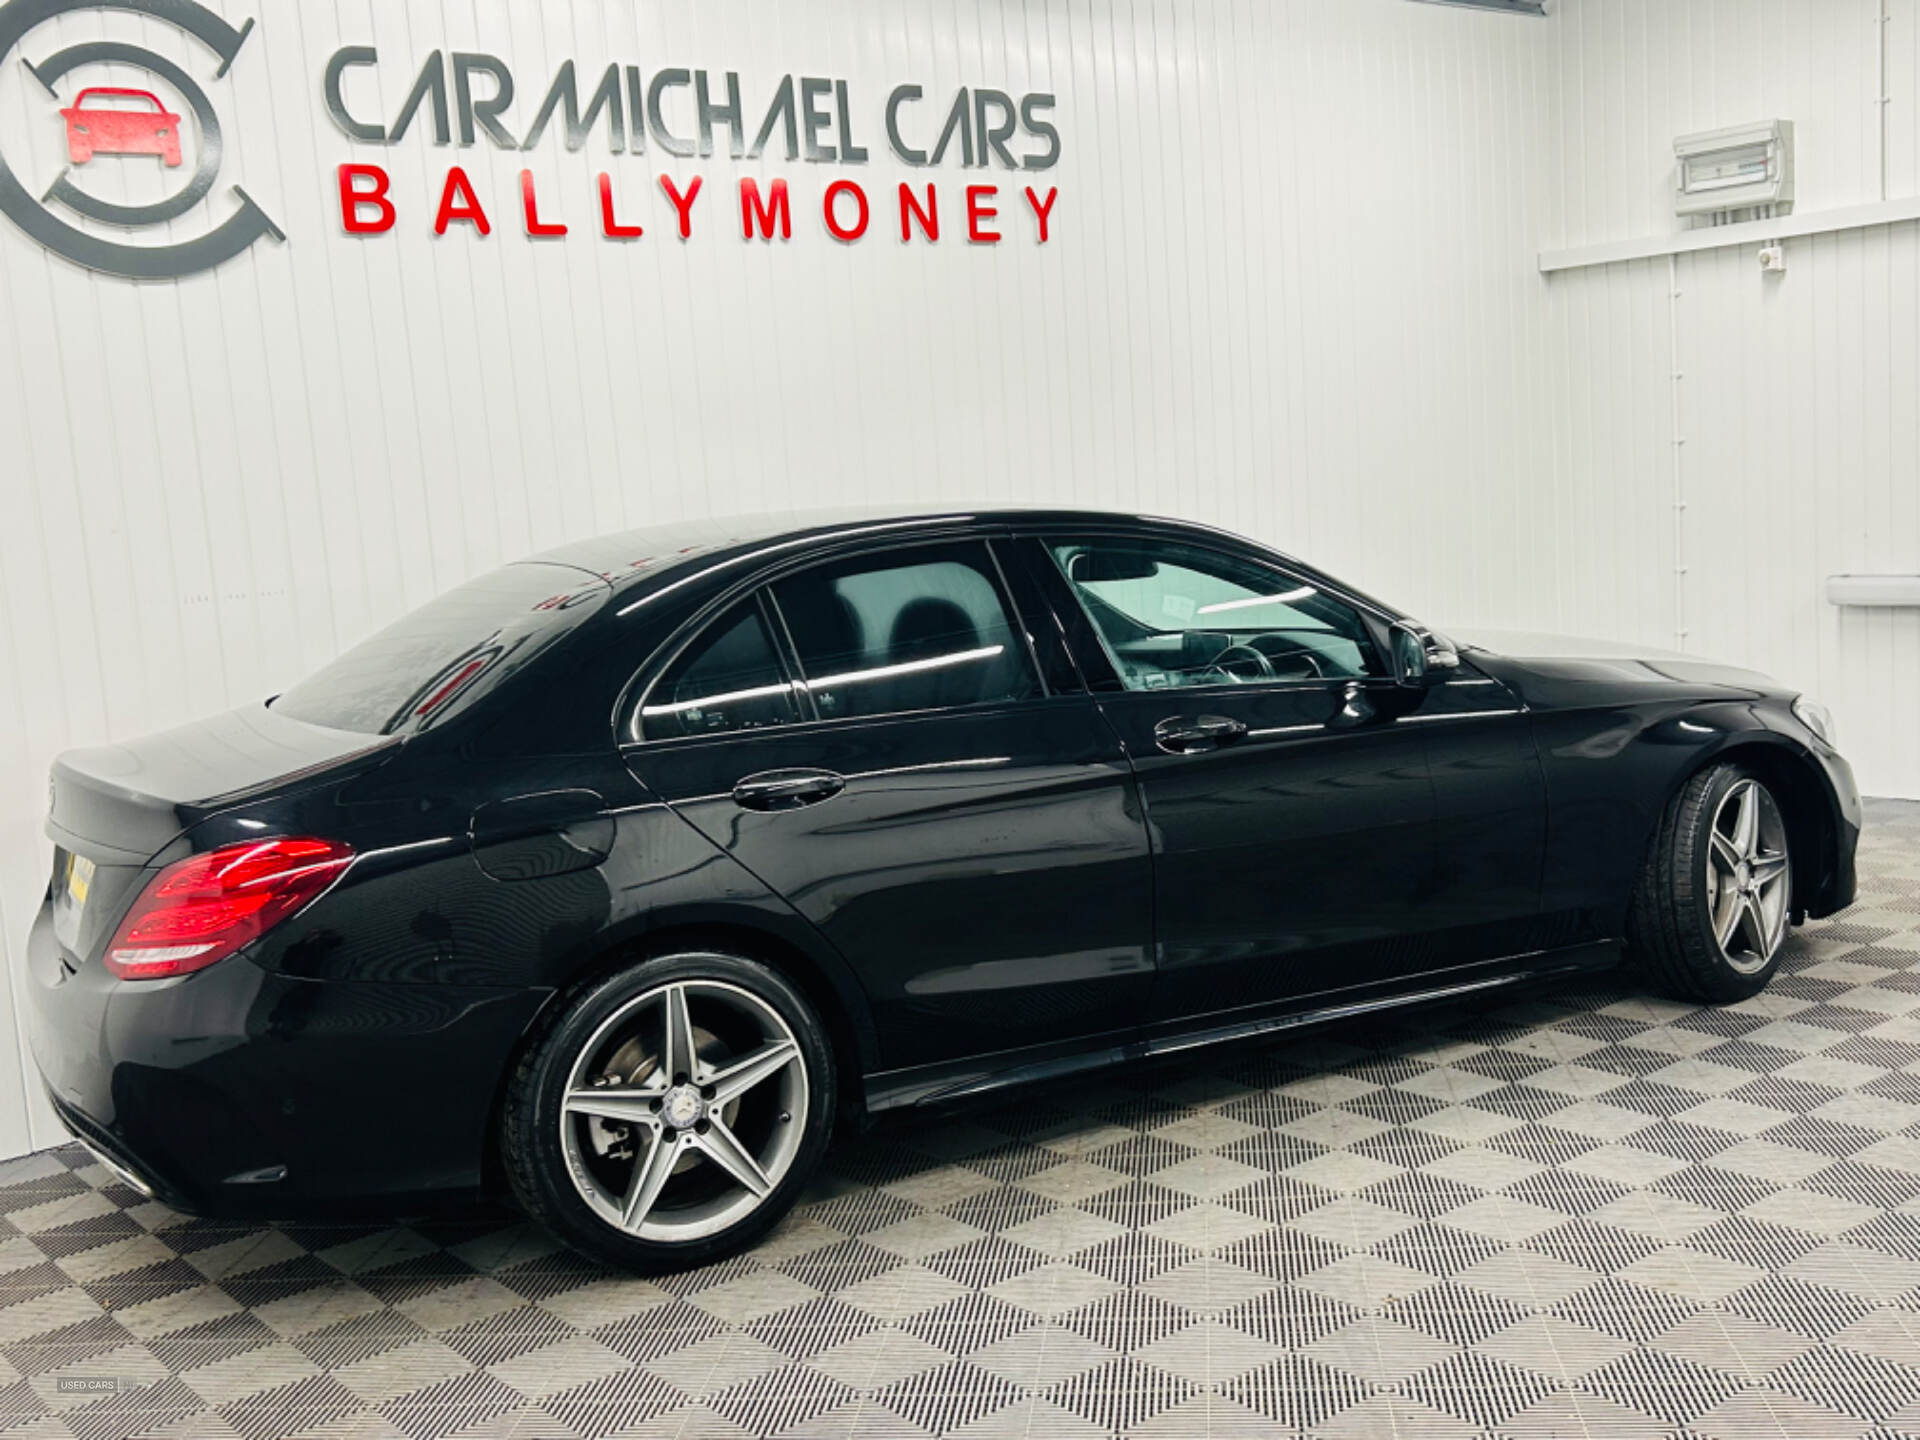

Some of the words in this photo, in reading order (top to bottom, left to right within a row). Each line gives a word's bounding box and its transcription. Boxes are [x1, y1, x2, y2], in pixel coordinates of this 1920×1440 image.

[324, 46, 868, 164] CARMICHAEL
[885, 84, 1061, 169] CARS
[338, 163, 1057, 243] BALLYMONEY
